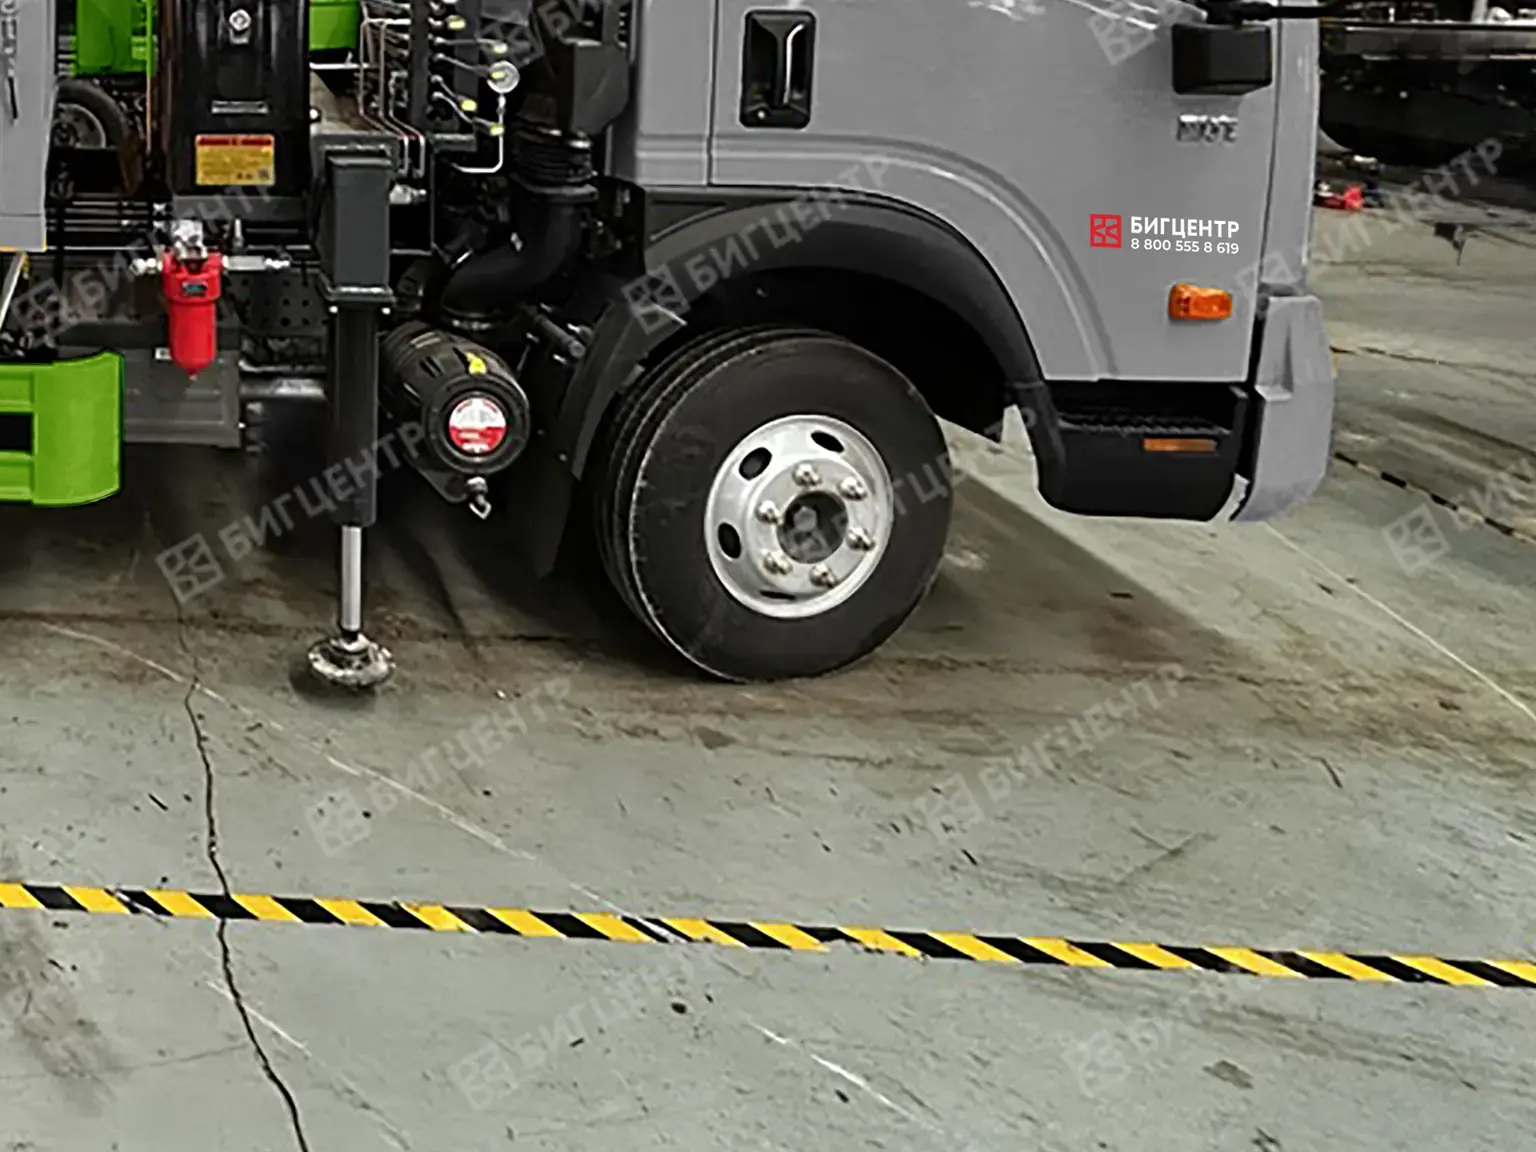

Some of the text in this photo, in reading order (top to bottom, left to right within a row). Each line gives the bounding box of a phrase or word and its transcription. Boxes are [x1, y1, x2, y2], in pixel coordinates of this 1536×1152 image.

[1130, 216, 1240, 239] БИГЦЕНТР
[1130, 238, 1239, 254] 8 800 555 8 619
